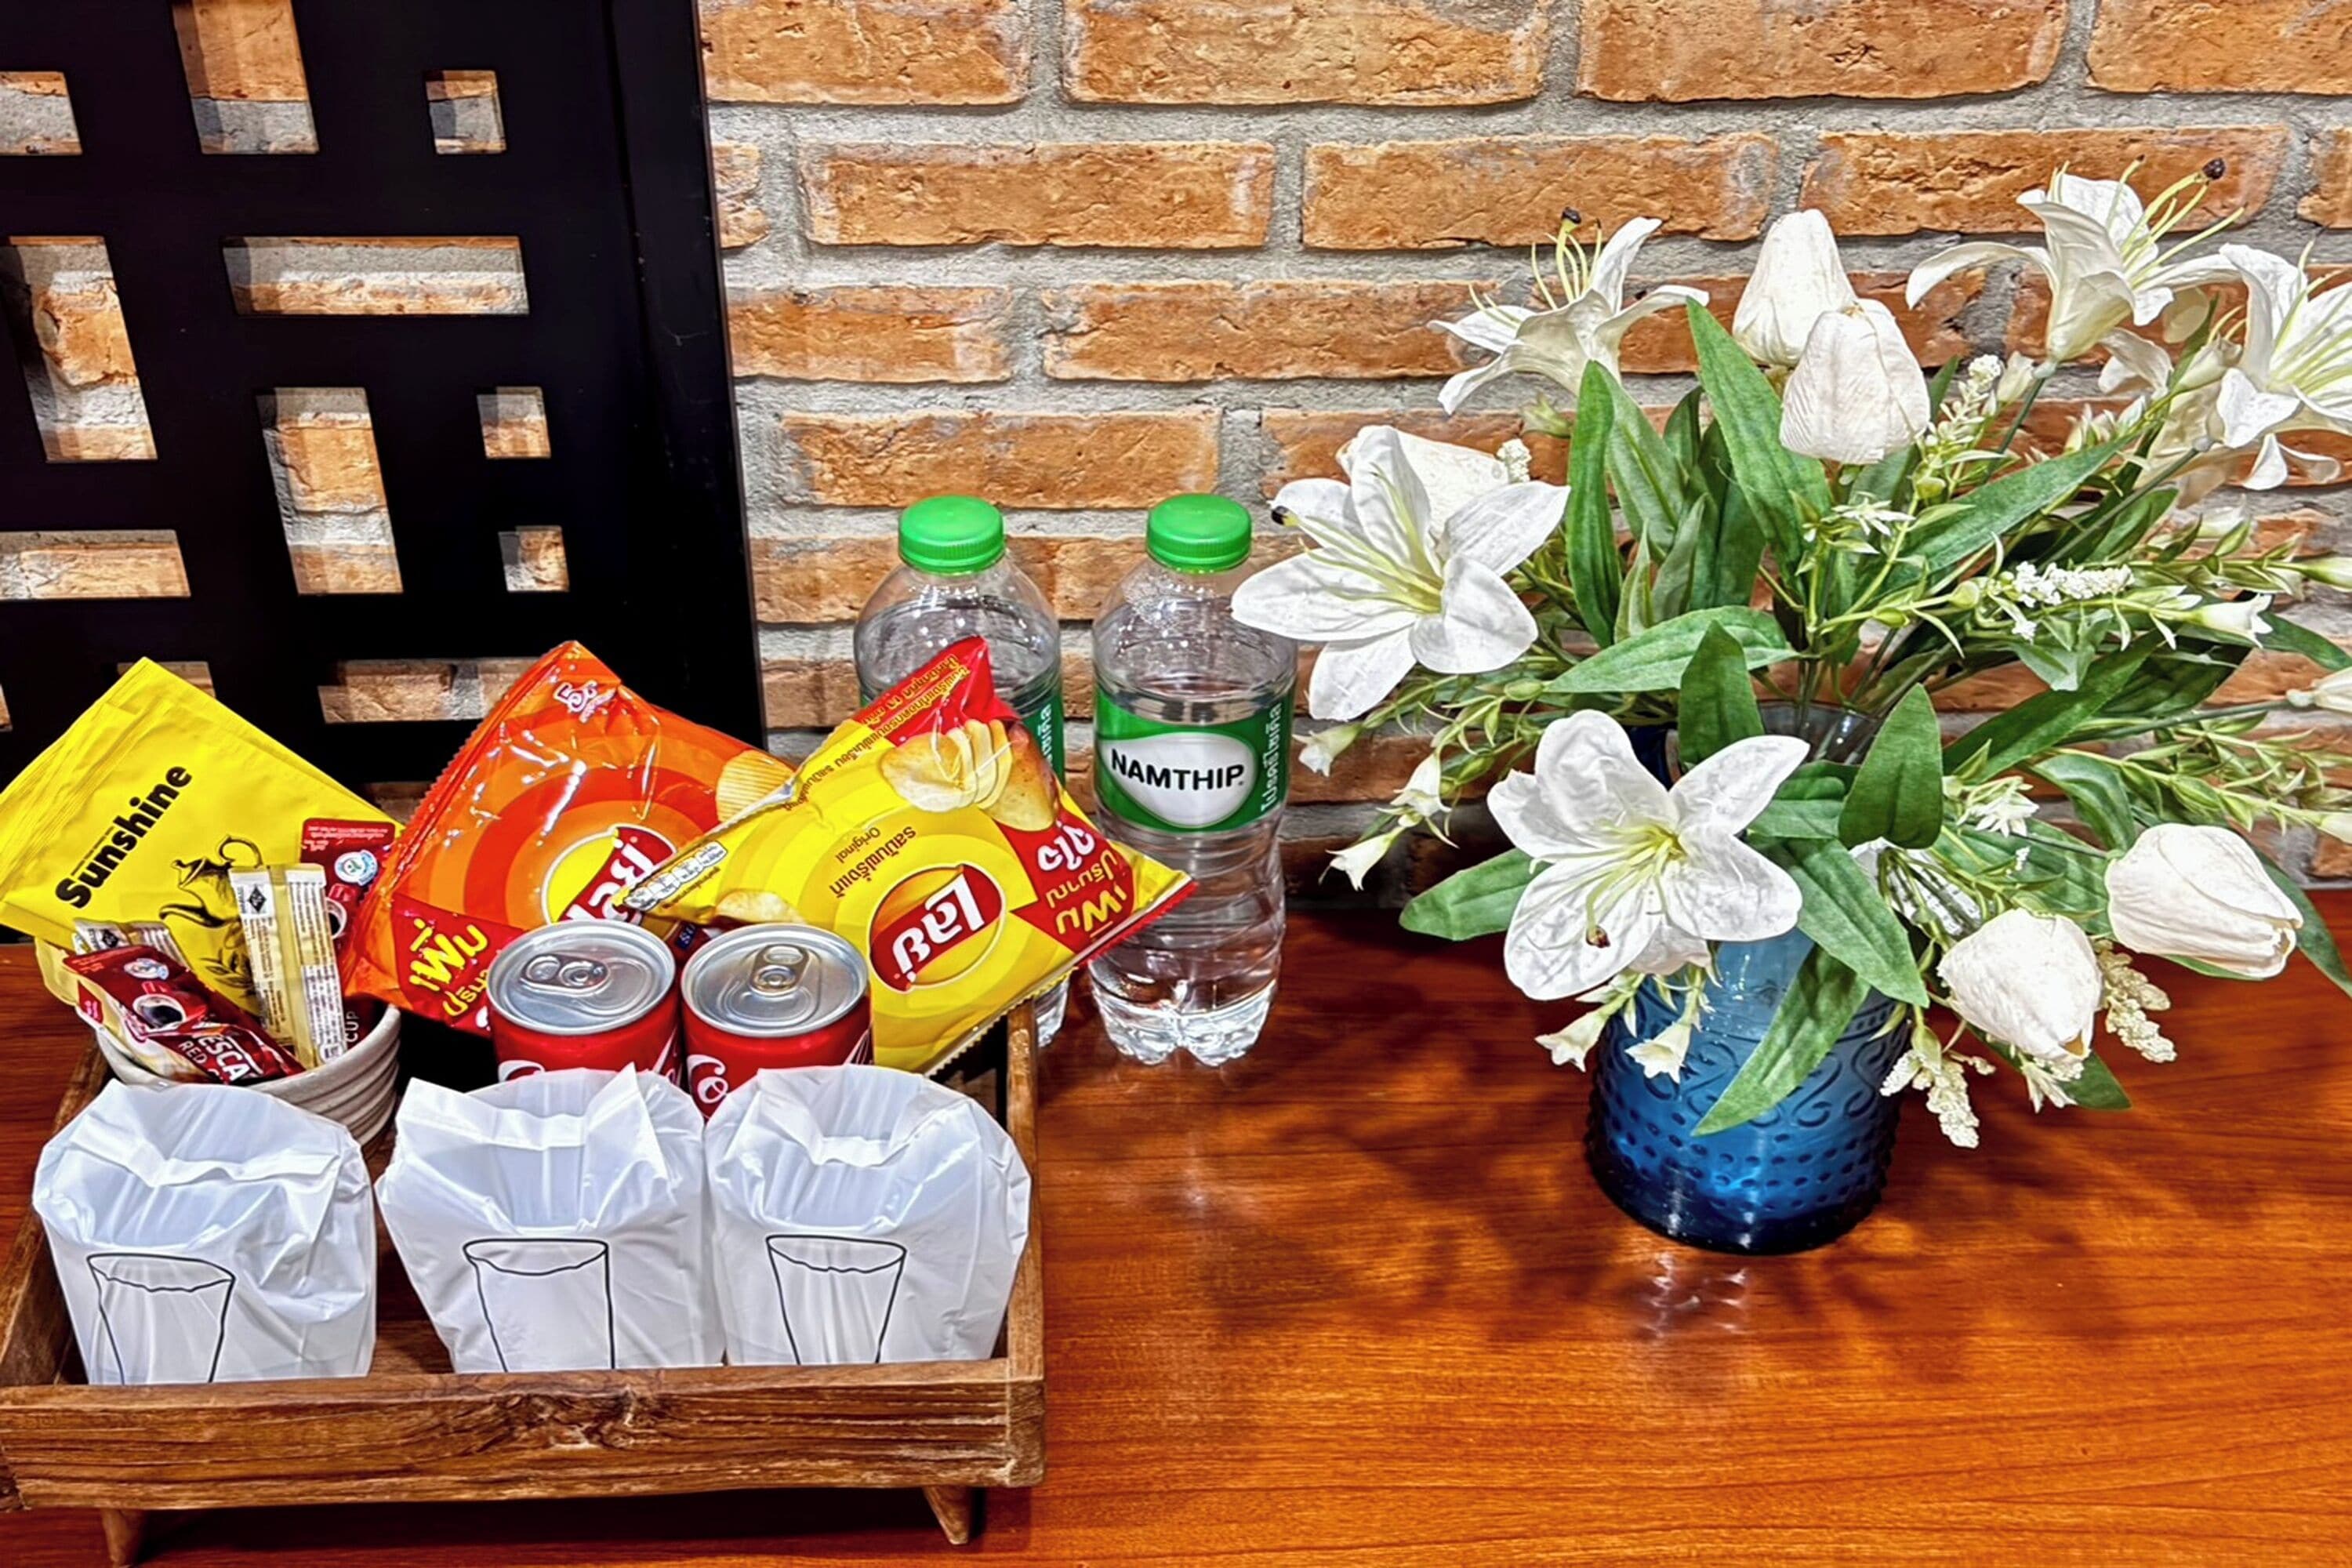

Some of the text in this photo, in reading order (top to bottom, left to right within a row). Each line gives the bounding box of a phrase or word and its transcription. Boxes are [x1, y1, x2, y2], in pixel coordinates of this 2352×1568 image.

[1111, 749, 1244, 790] NAMTHIP
[56, 765, 192, 909] Sunshine
[837, 828, 880, 862] Original
[1039, 822, 1094, 870] จุใจ
[830, 827, 916, 898] รสมันฝรั่งแท้
[1047, 851, 1116, 907] ปริมาณ
[894, 875, 984, 982] เลย์
[1057, 886, 1127, 937] เพิ่ม
[408, 918, 488, 991] เพิ่ม
[344, 1011, 359, 1042] CUP
[178, 1040, 207, 1064] RED
[196, 1033, 255, 1081] ESCA
